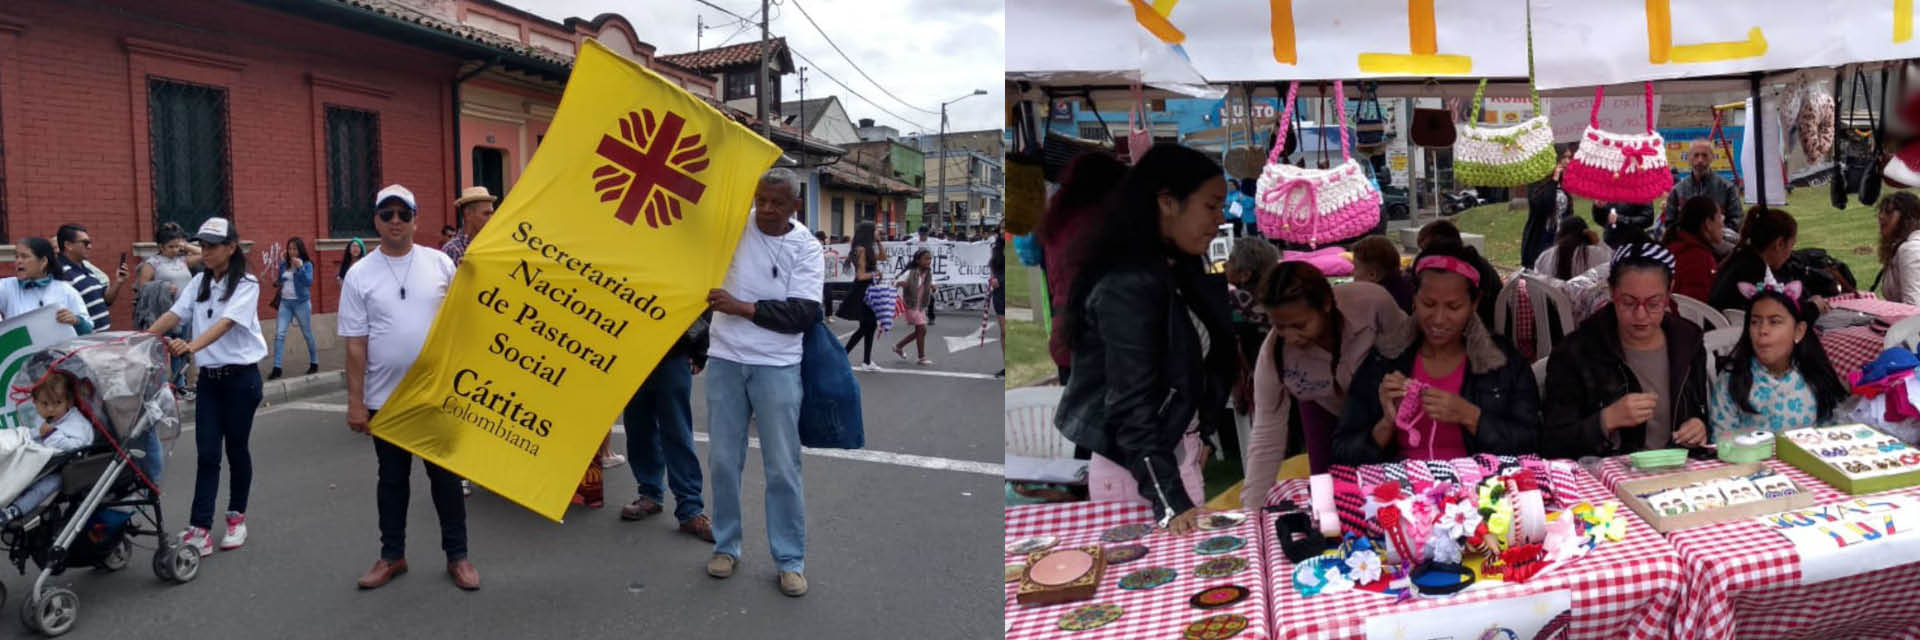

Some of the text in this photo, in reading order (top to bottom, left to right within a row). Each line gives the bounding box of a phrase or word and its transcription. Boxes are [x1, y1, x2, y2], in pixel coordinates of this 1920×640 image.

[508, 260, 630, 340] Nacional
[511, 221, 668, 322] Secretariado
[477, 286, 619, 375] de Pastoral
[488, 332, 568, 388] Social
[440, 394, 541, 457] Colombiana
[452, 368, 553, 438] Cáritas
